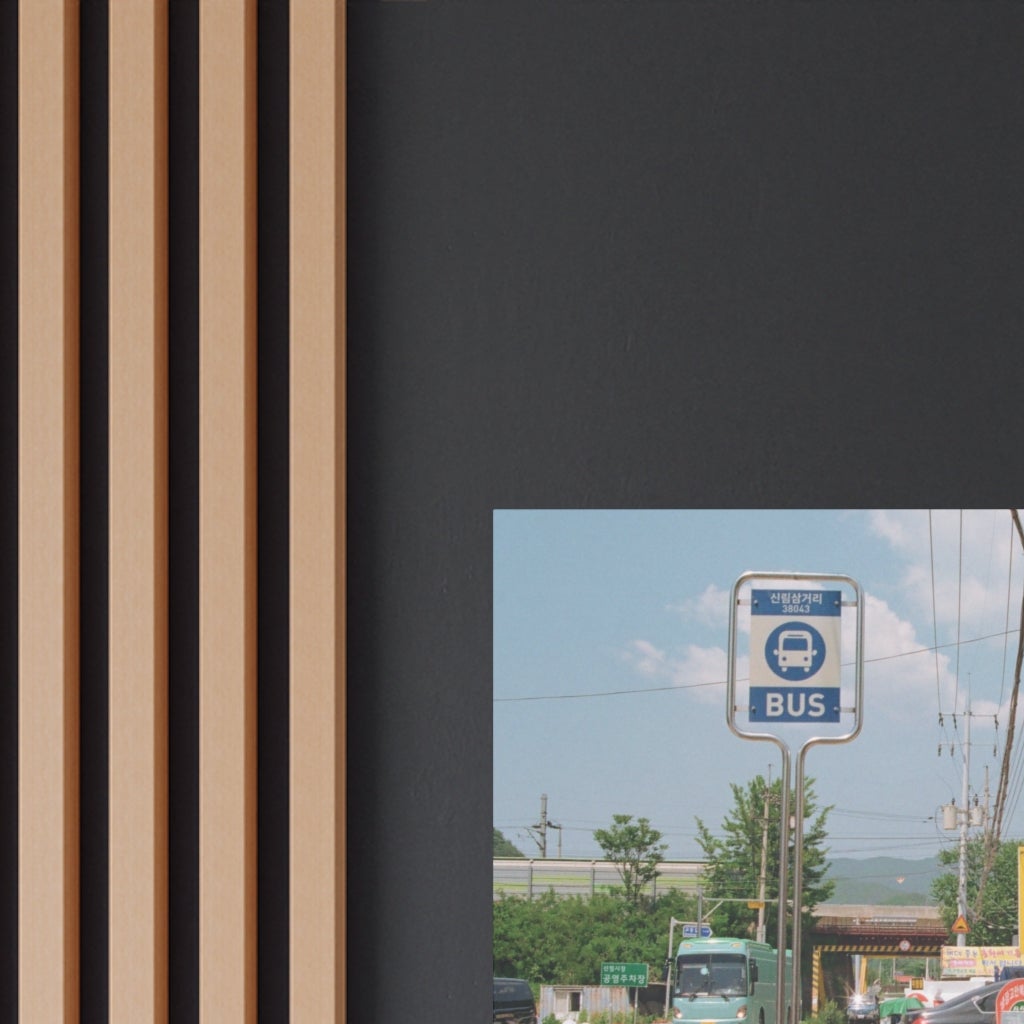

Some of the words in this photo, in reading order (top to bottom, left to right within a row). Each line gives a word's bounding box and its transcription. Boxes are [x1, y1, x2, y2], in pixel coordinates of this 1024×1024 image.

[770, 592, 823, 605] 신림삼거리
[782, 605, 811, 613] 38043
[766, 692, 826, 717] BUS
[602, 974, 645, 984] 공영주차장
